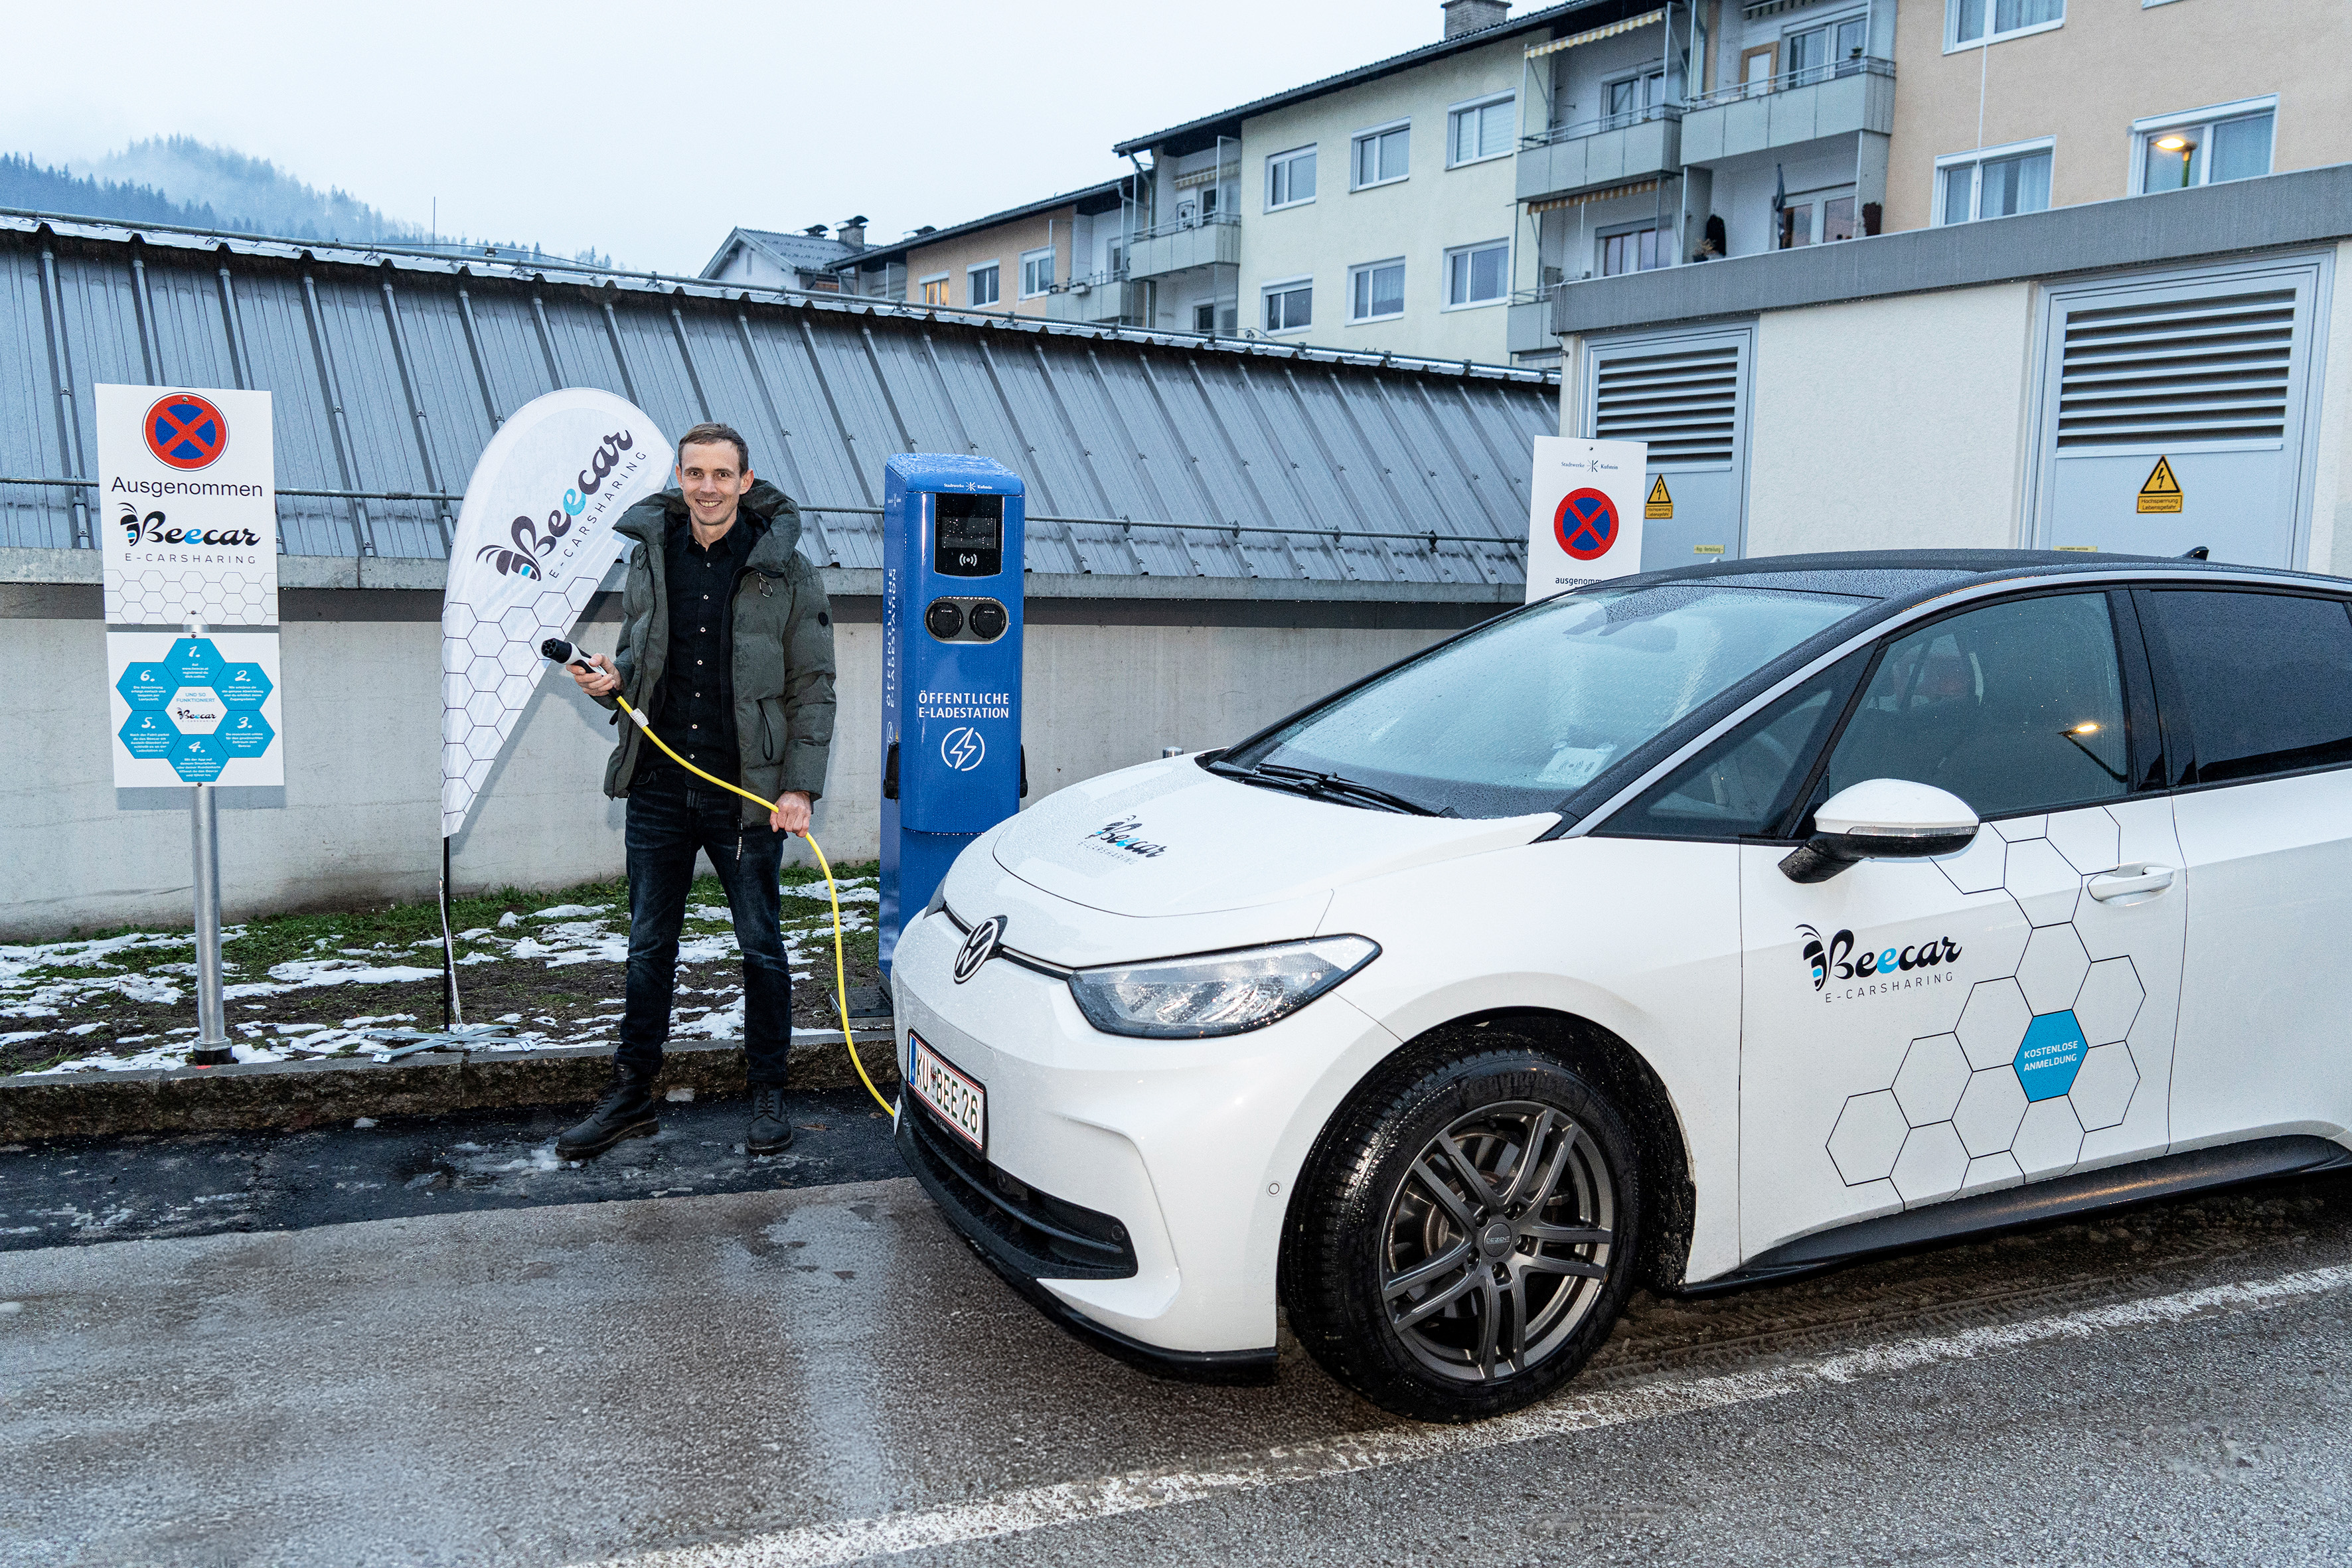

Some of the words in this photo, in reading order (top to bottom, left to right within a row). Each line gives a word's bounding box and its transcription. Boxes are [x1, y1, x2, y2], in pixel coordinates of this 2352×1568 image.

[111, 476, 263, 498] Ausgenommen
[511, 430, 633, 569] Beecar
[549, 451, 647, 579] E-CARSHARING
[139, 510, 262, 546] Beecar
[125, 553, 256, 564] E-CARSHARING
[1555, 578, 1603, 586] ausgenomm
[188, 645, 201, 658] 1.
[140, 669, 155, 682] 6.
[234, 670, 251, 682] 2.
[918, 690, 1010, 705] ÖFFENTLICHE
[183, 709, 217, 720] Beecar
[918, 707, 1009, 719] E-LADESTATION
[141, 716, 156, 729] 5.
[237, 716, 253, 729] 3.
[188, 741, 206, 753] 4.
[1099, 823, 1168, 858] Beecar
[1826, 929, 1963, 983] Beecar
[1826, 971, 1953, 1003] E-CARSHARING
[2024, 1040, 2078, 1059] KOSTENLOSE
[2023, 1053, 2077, 1072] ANMELDUNG
[917, 1048, 931, 1093] KU
